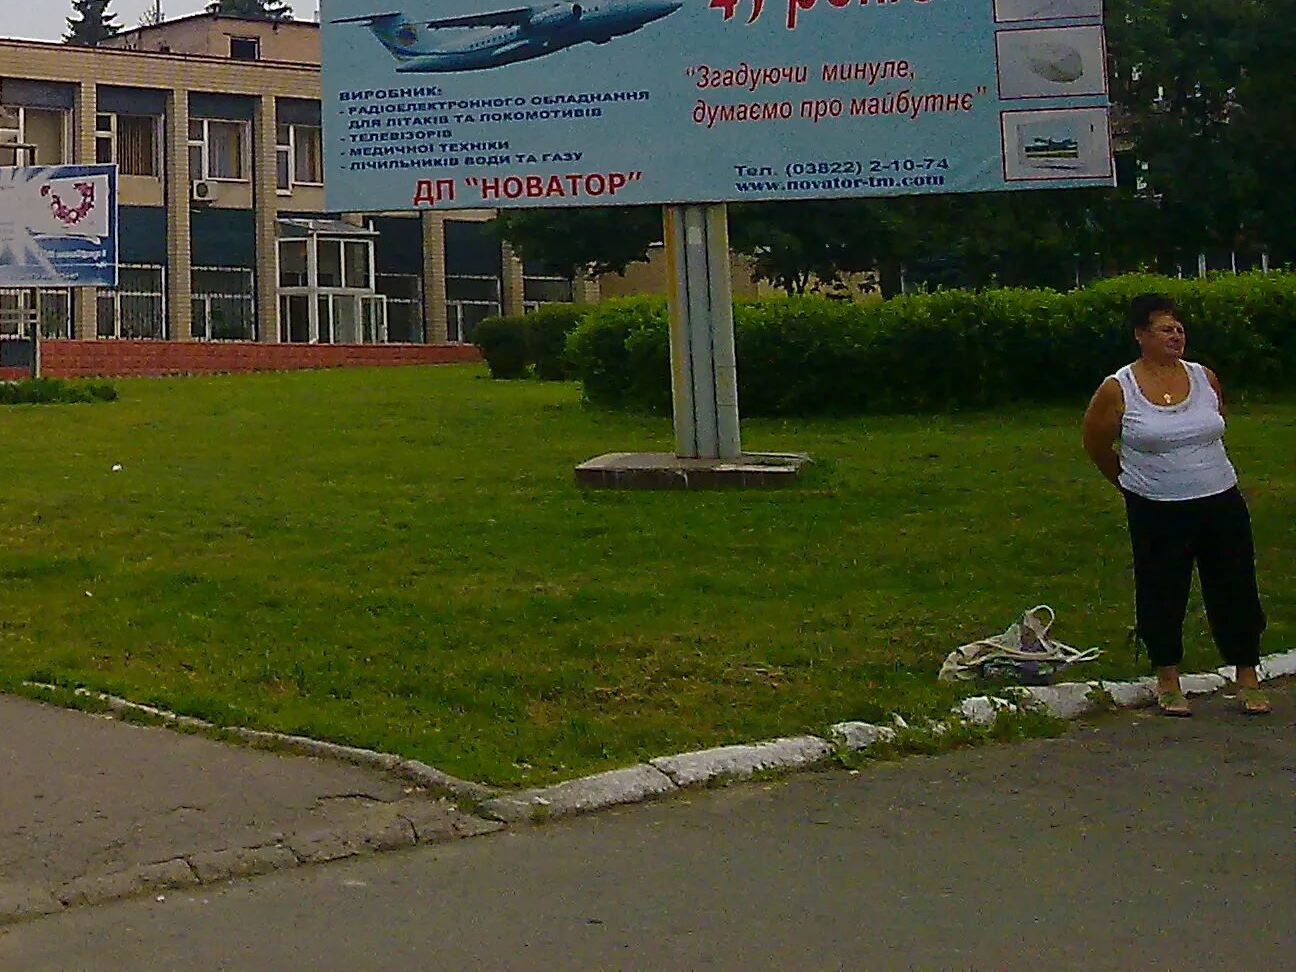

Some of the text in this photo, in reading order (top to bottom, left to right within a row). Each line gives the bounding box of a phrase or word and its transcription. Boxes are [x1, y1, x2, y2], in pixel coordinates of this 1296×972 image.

[822, 59, 916, 86] минуле,
[339, 86, 442, 102] ВИРОБНИК:
[348, 90, 650, 116] РАДІОЕЛЕКТРОННОГО ОБЛАДНАННЯ
[692, 85, 988, 129] думаємо про майбутнє"
[348, 107, 603, 130] ДЛЯ ЛІТАКІВ ТА ЛОКОМОТИВІВ
[349, 129, 453, 143] ТЕЛЕВІЗОРІВ
[439, 140, 510, 152] ТЕХНІКИ
[349, 151, 584, 172] ЛІЧИЛЬНИКІВ ВОДИ ТА ГАЗУ
[735, 157, 951, 178] Тел. (03822) 2-10-74
[412, 171, 643, 207] ДП "НОВАТОР"
[735, 173, 945, 192] www.novator-tm.com
